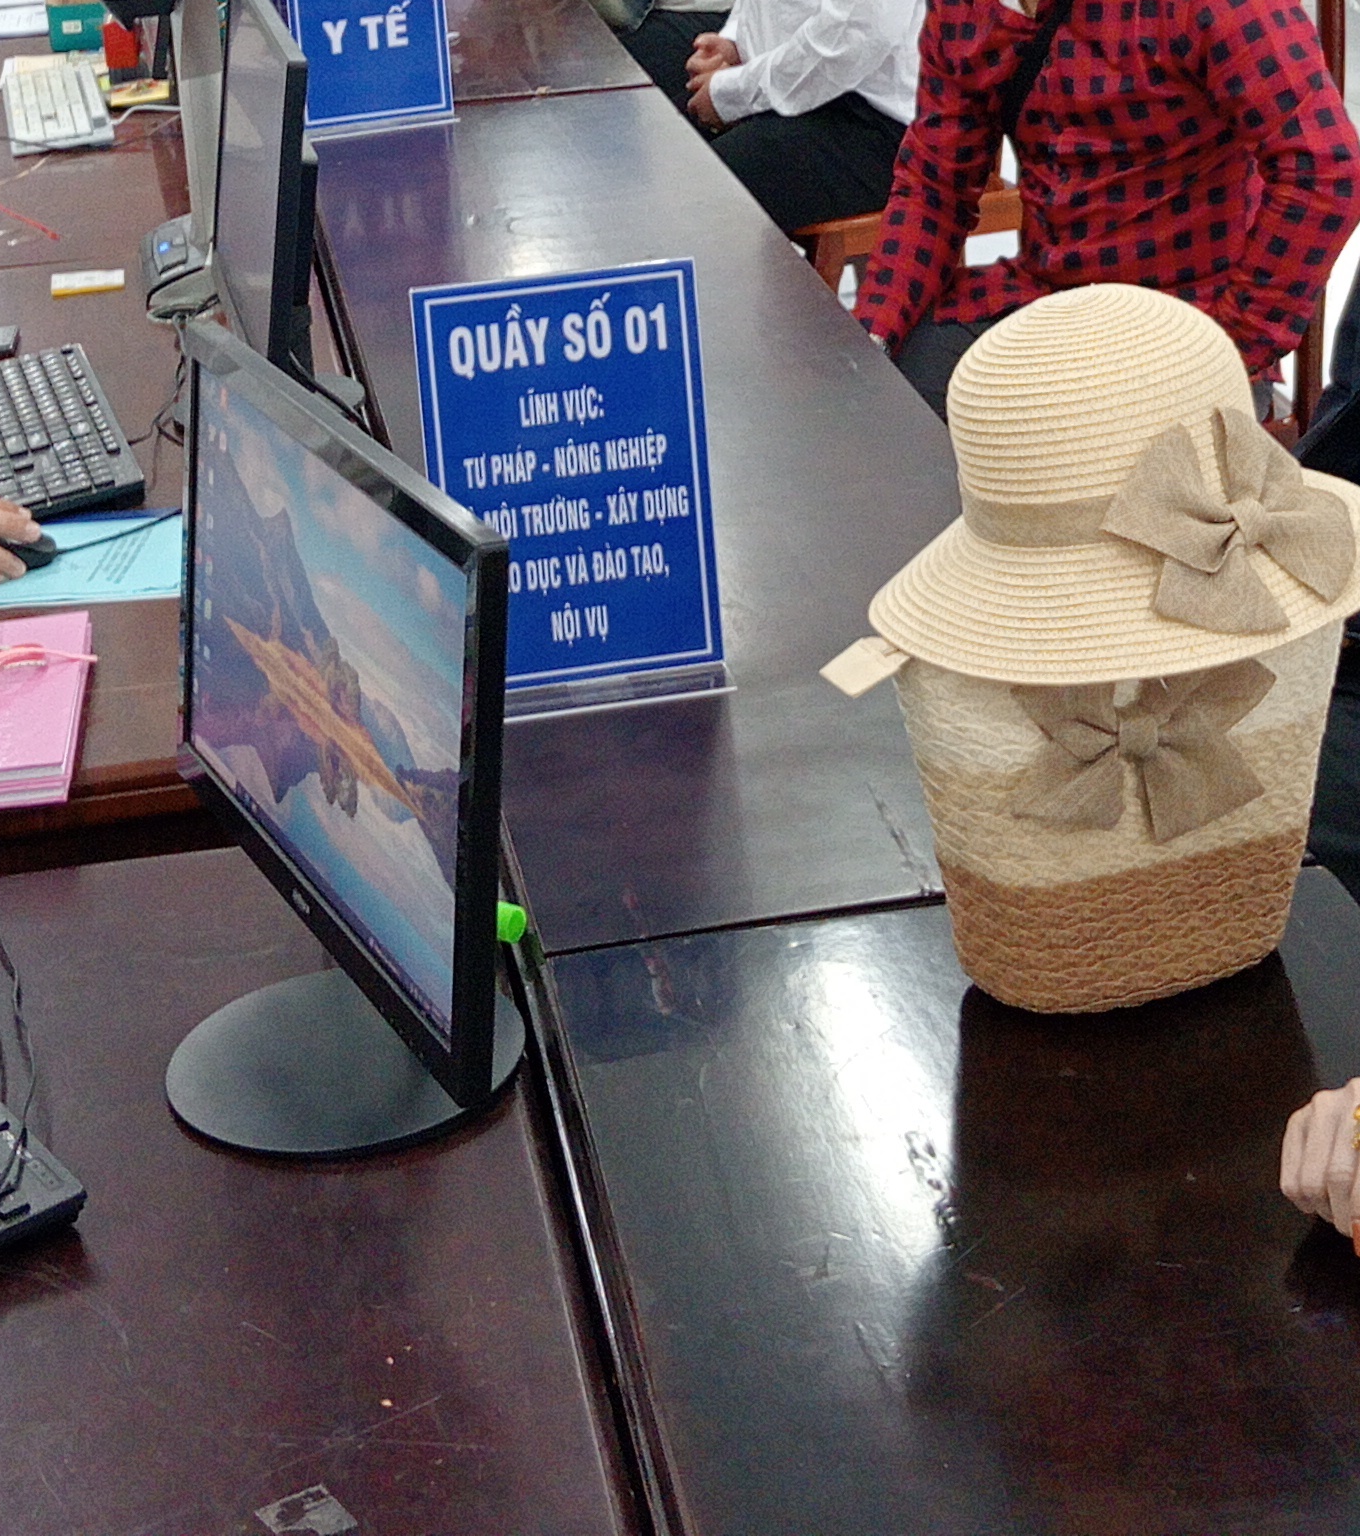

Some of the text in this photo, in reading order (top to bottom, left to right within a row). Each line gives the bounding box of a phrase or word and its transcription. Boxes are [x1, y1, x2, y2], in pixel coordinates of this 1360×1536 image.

[322, 0, 412, 56] Y TẾ
[449, 291, 670, 381] QUẦY SỐ 01
[561, 383, 606, 429] VỰC:
[463, 452, 487, 490] TƯ
[490, 444, 538, 487] PHÁP
[553, 437, 602, 479] NÔNG
[604, 426, 668, 474] NGHIỆP
[520, 493, 591, 538] TRƯỜNG
[605, 485, 639, 527] XÂY
[642, 484, 690, 527] DỰNG
[526, 556, 562, 597] DỤC
[564, 545, 590, 587] VÀ
[591, 541, 628, 583] ĐÀO
[630, 541, 670, 583] TẠO,
[550, 601, 609, 648] NỘI VỤ
